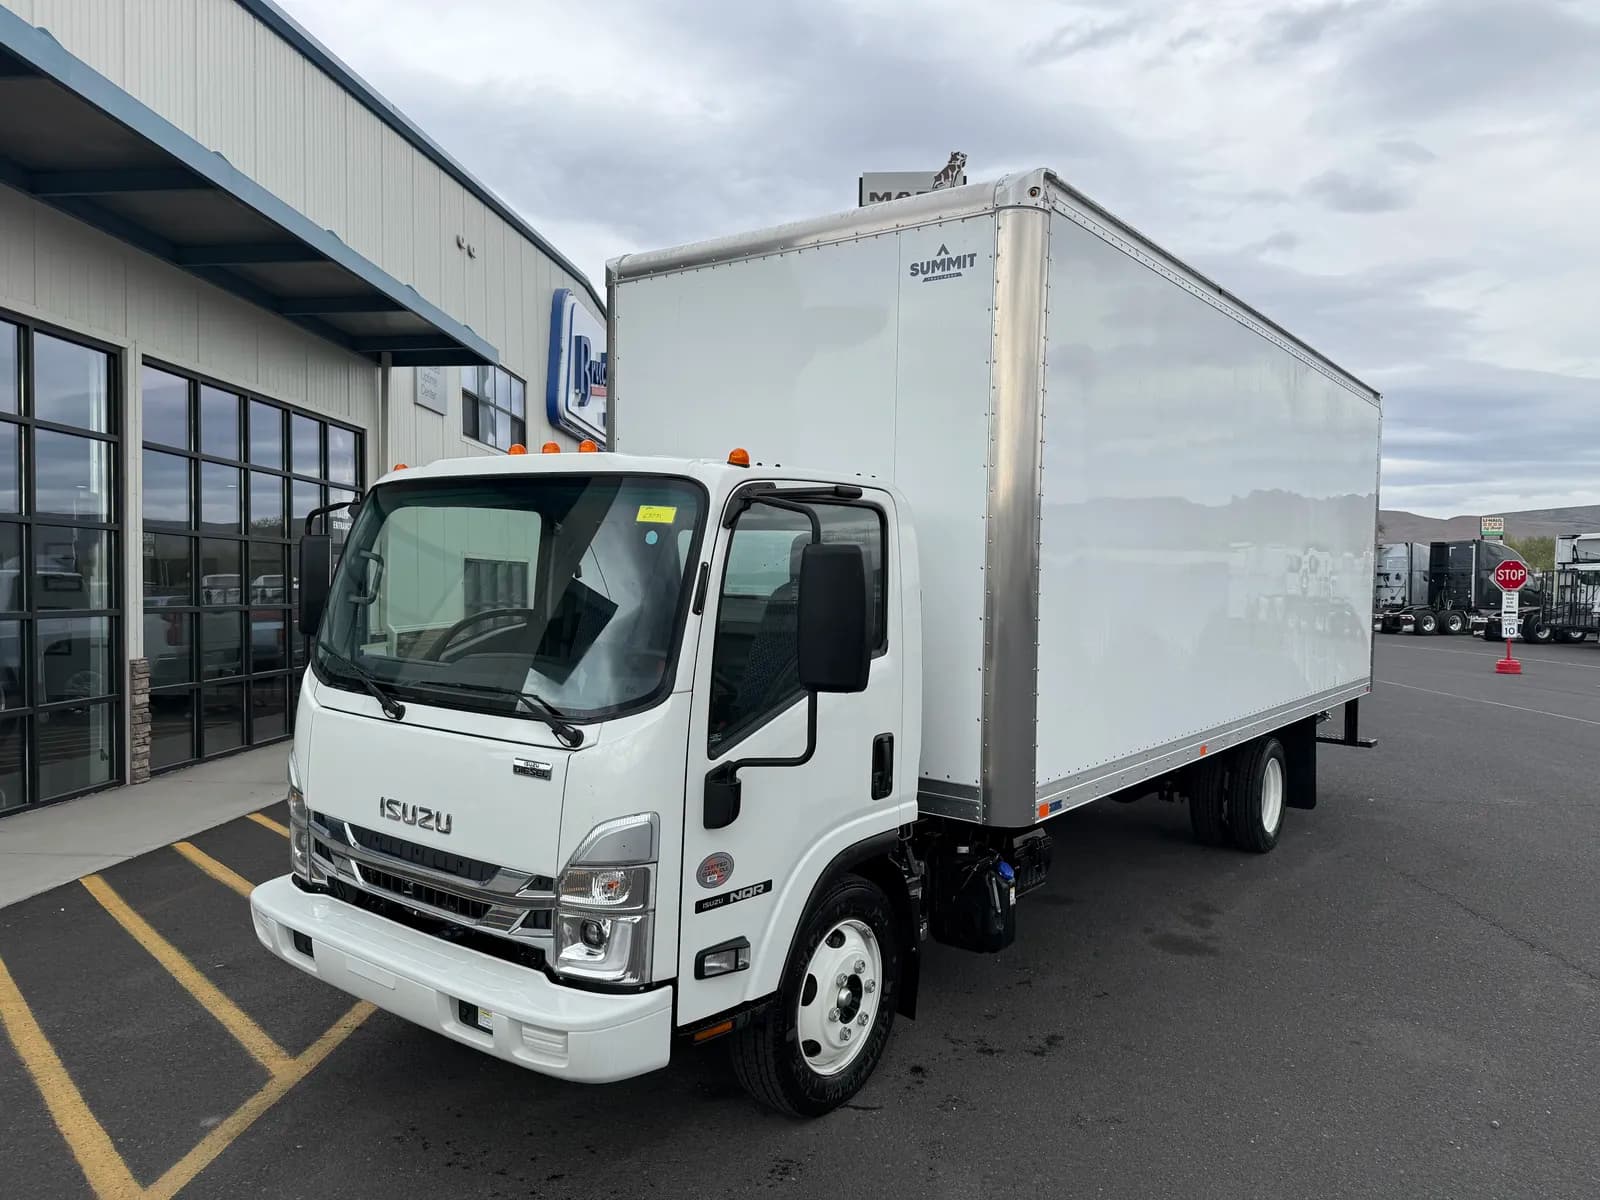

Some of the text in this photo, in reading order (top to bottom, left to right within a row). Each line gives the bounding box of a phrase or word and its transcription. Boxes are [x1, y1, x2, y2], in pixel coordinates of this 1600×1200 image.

[910, 253, 977, 277] SUMMIT
[1497, 569, 1525, 580] STOP
[1504, 627, 1515, 635] 10
[515, 766, 550, 780] DIESEL
[379, 796, 453, 835] ISUZU
[702, 884, 764, 909] ISUZU NQR
